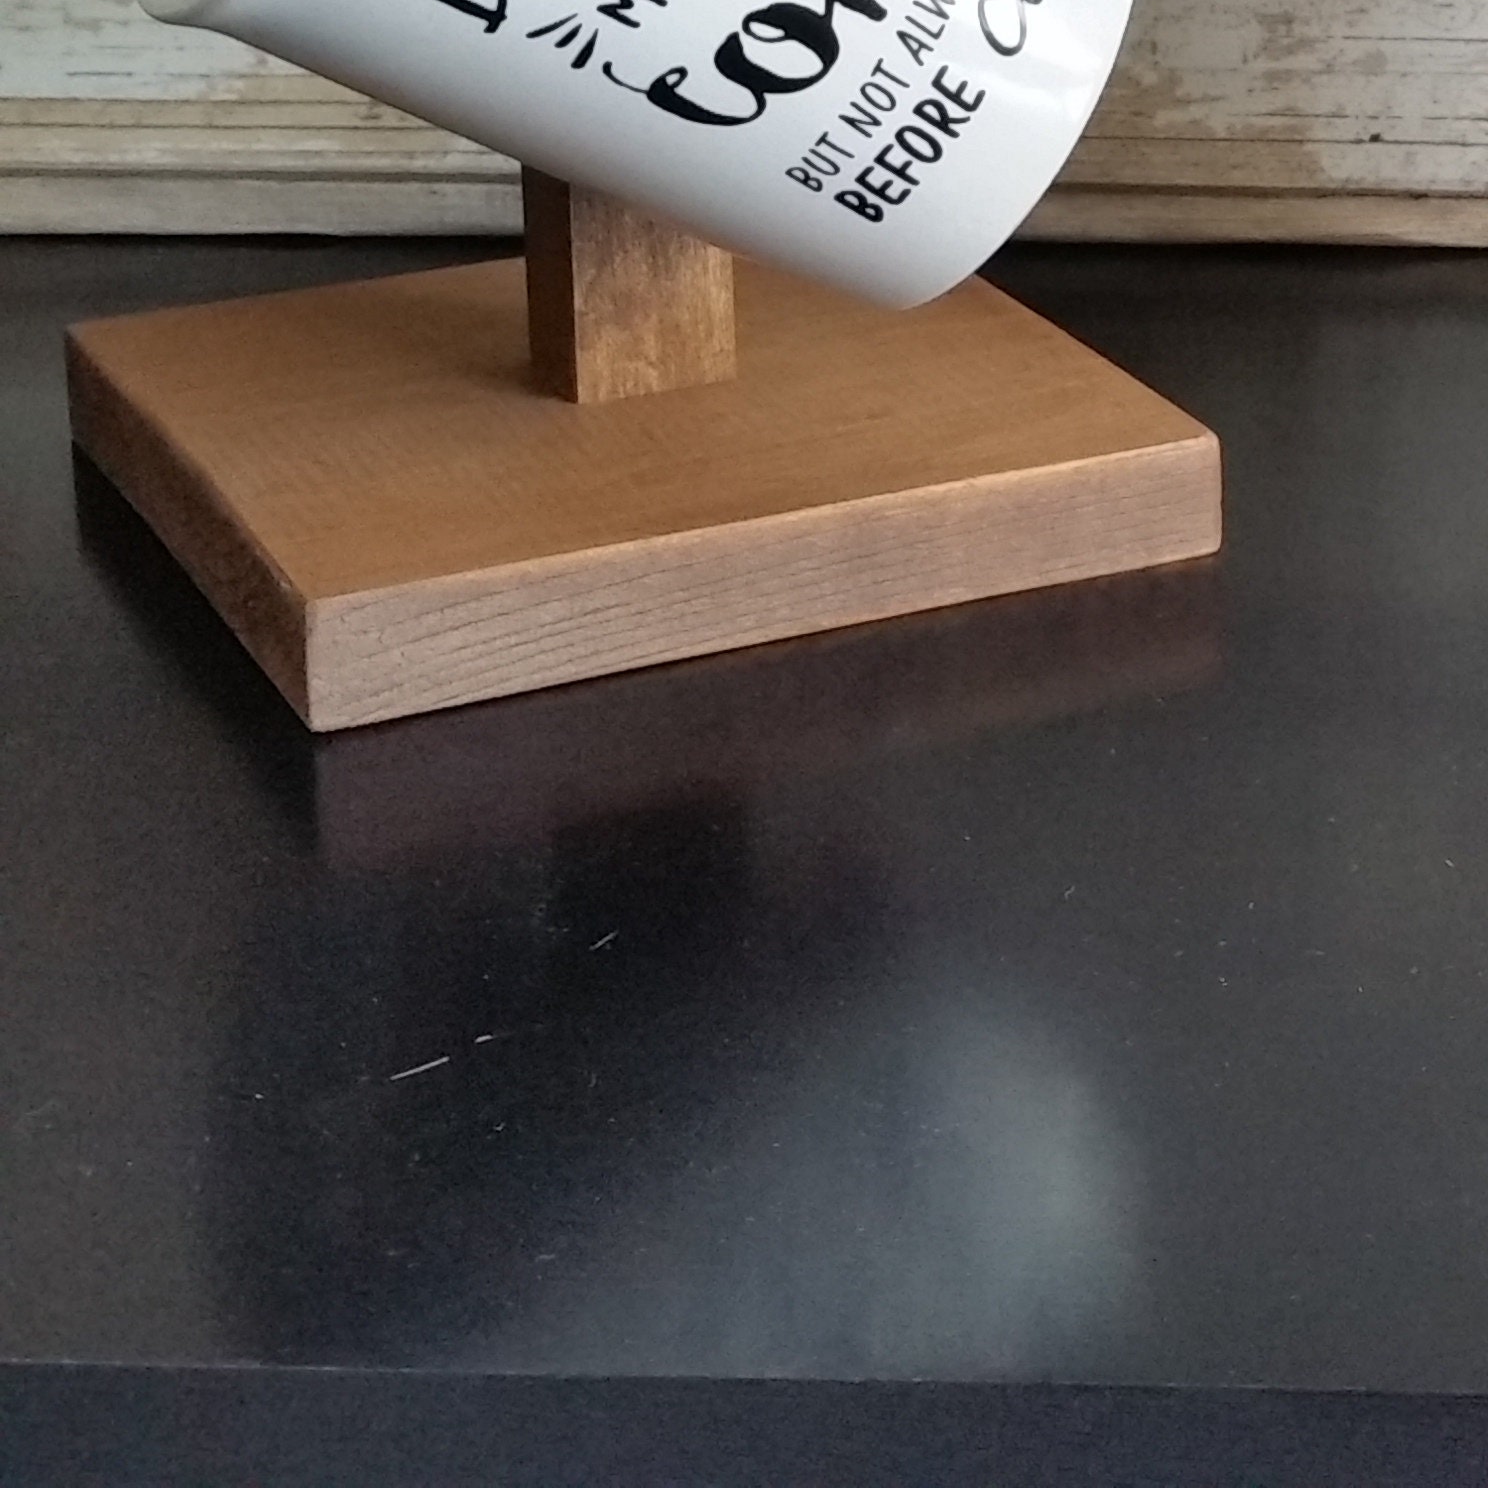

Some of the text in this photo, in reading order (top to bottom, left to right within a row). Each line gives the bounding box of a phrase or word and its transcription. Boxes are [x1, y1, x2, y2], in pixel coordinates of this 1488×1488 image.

[784, 130, 855, 193] BUT
[838, 57, 911, 138] NOT
[832, 64, 987, 223] BEFORE
